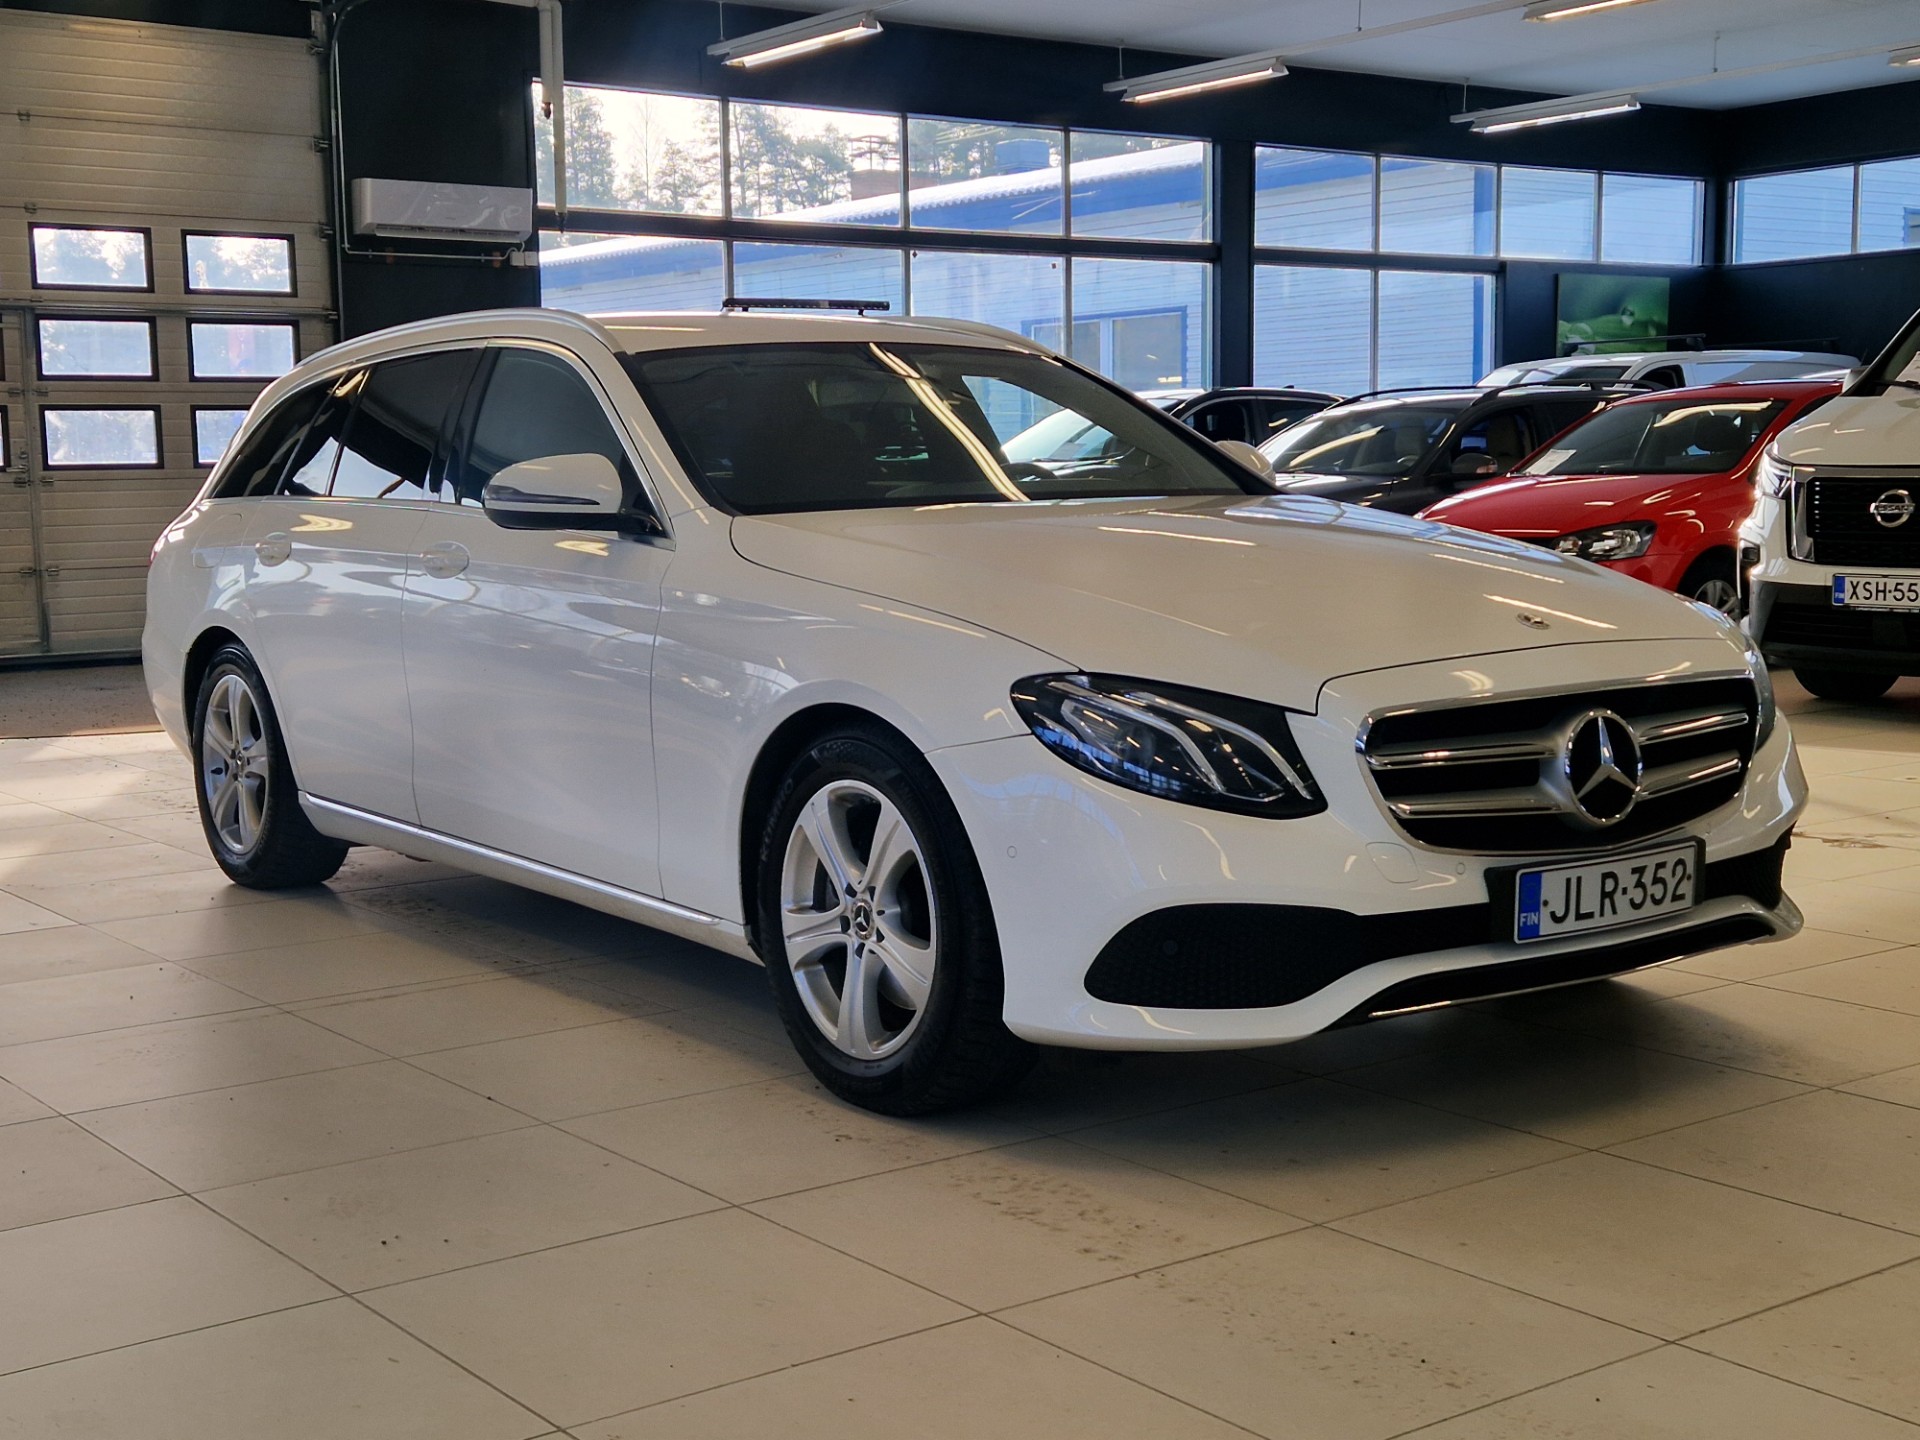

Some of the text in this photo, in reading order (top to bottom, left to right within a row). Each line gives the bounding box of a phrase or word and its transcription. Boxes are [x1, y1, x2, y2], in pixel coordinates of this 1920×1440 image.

[1849, 580, 1919, 603] XSH-55
[1549, 857, 1687, 924] JLR-352
[1519, 911, 1540, 927] FIN
